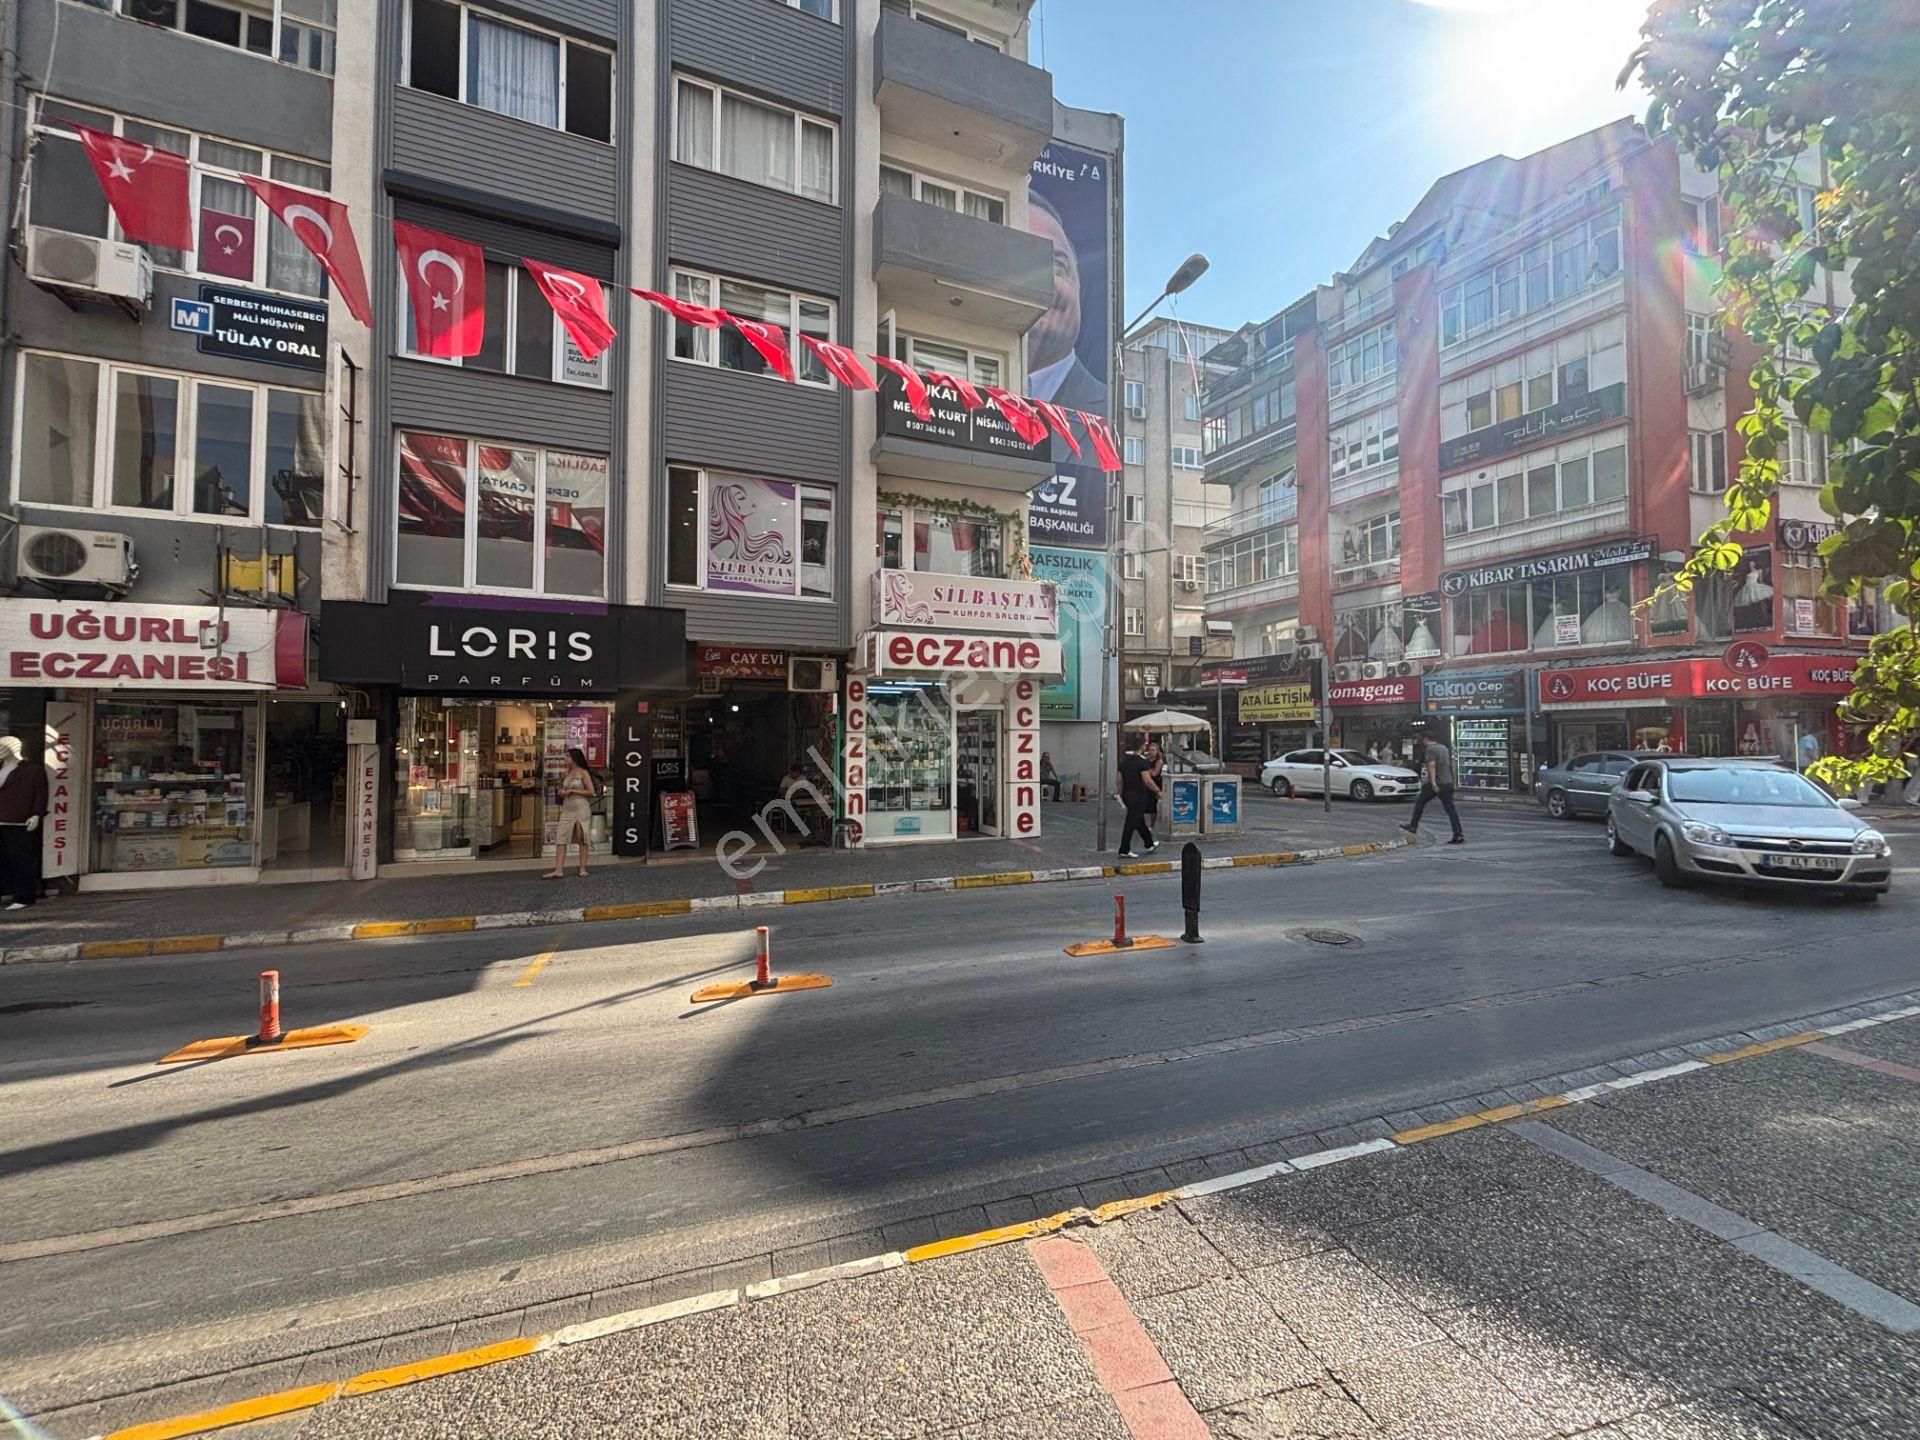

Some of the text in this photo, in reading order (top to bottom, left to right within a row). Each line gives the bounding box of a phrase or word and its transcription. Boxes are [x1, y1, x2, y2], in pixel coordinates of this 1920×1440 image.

[213, 296, 325, 323] SERBEST MUHASEBECİ
[233, 312, 306, 332] MALİ MÜŞAVİR
[216, 329, 321, 358] TÜLAY ORAL
[938, 409, 968, 424] KURT
[1029, 516, 1094, 535] BAŞKANLIĞI
[710, 560, 793, 578] SİLBAŞTAN
[1469, 567, 1515, 588] KİBAR
[1518, 552, 1590, 579] TASARIM
[933, 584, 1053, 612] SİLBAŞTAN
[995, 611, 1032, 621] SALONU
[730, 652, 758, 666] ÇAY
[760, 651, 784, 666] EVİ
[888, 636, 1041, 669] eczane
[9, 651, 249, 681] ECZANESİ
[1811, 667, 1855, 683] KOÇ BÜFE
[428, 674, 593, 687] PARFÜM
[1424, 680, 1503, 698] Tekno Cep
[1587, 672, 1673, 693] KOÇ BÜFE
[1706, 674, 1793, 692] KOÇ BÜFE
[1241, 695, 1262, 707] ATA
[848, 680, 864, 844] eczane
[1015, 680, 1034, 834] eczane
[53, 732, 71, 867] ECZANESİ
